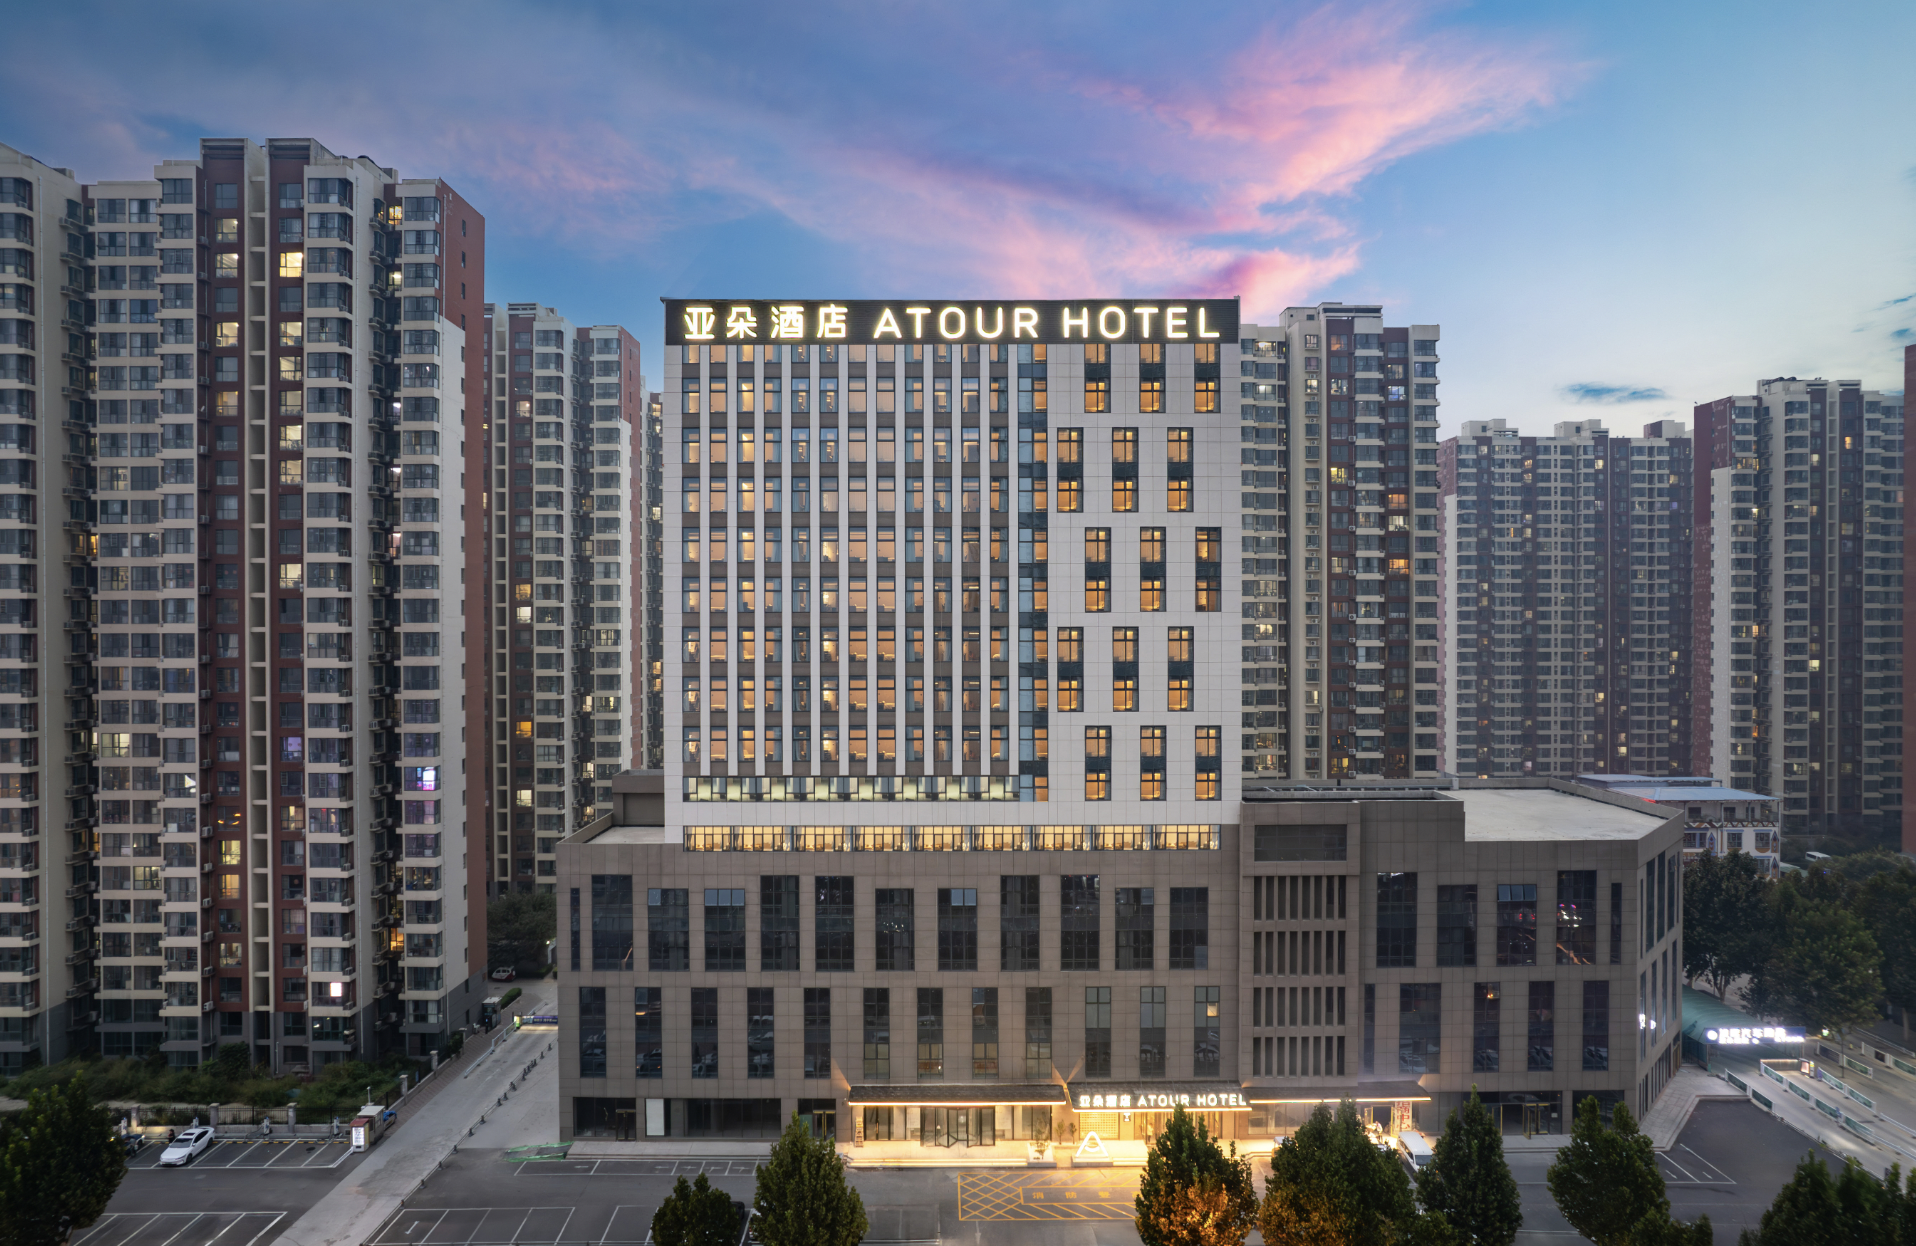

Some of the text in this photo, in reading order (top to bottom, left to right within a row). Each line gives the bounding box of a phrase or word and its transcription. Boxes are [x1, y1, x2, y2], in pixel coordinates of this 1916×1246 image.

[683, 304, 1221, 339] 亚朵酒店 ATOUR HOTEL
[1079, 1094, 1247, 1108] 亚朵酒店 ATOUR HOTEL
